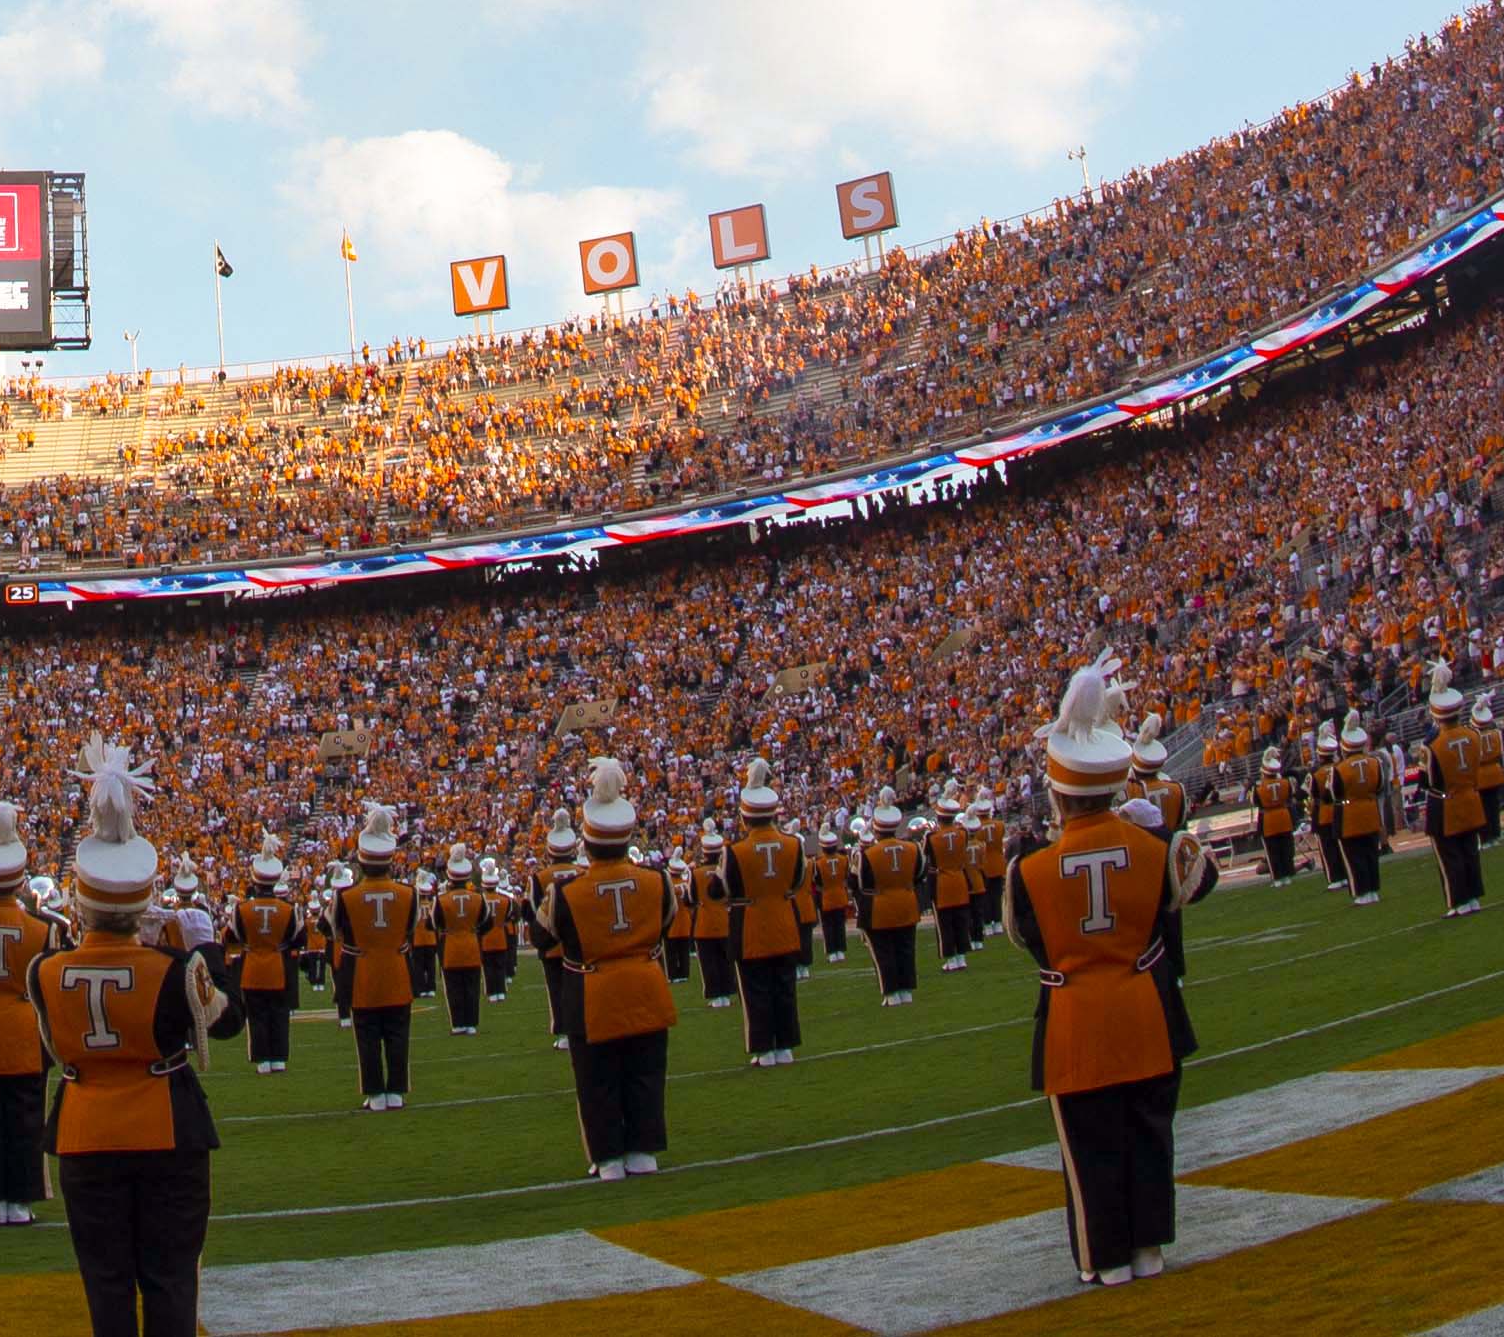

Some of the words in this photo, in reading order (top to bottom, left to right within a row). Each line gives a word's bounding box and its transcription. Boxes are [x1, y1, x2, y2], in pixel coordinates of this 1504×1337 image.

[10, 586, 34, 600] 25
[1448, 737, 1470, 772] T
[1351, 758, 1373, 784] T
[1266, 782, 1282, 802] T
[943, 831, 958, 851] T
[967, 844, 981, 865] T
[755, 841, 781, 877] T
[827, 858, 839, 875] T
[884, 844, 904, 872] T
[1059, 847, 1131, 935] T
[253, 905, 278, 934] T
[364, 891, 396, 927] T
[452, 894, 471, 918] T
[596, 878, 637, 934] T
[61, 966, 134, 1051] T
